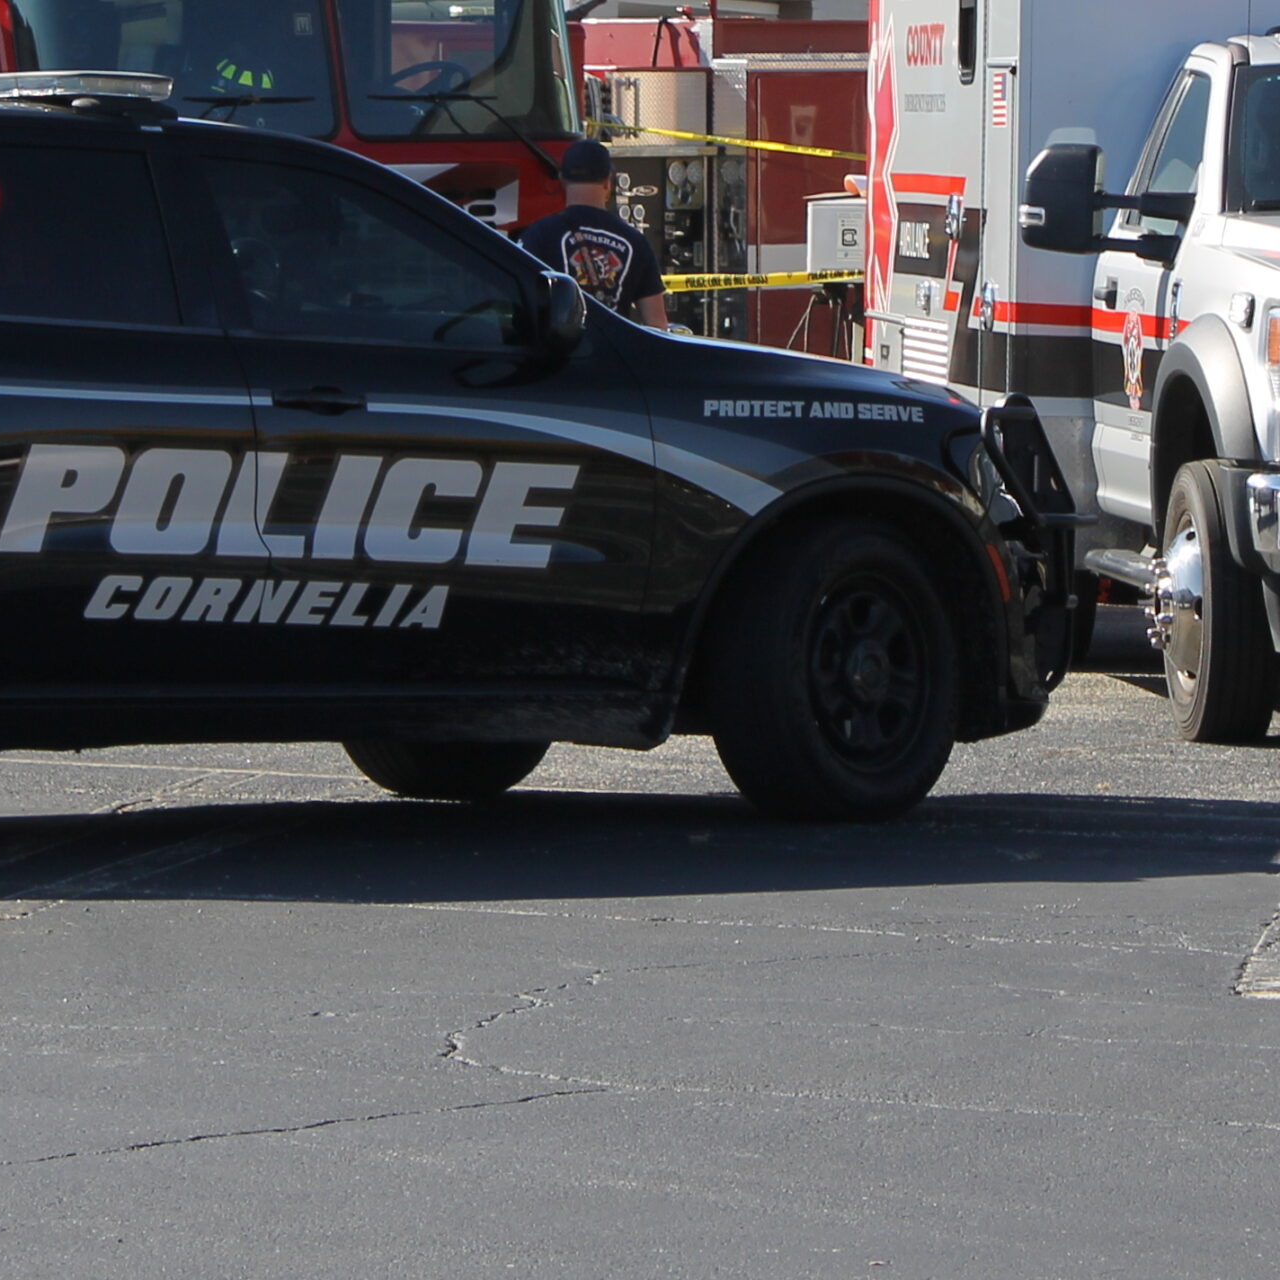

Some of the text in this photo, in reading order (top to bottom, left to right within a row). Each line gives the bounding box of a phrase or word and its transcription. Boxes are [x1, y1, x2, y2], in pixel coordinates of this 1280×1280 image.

[906, 22, 945, 67] COUNTY
[703, 400, 924, 422] PROTECT AND SERVE
[83, 575, 450, 629] CORNELIA
